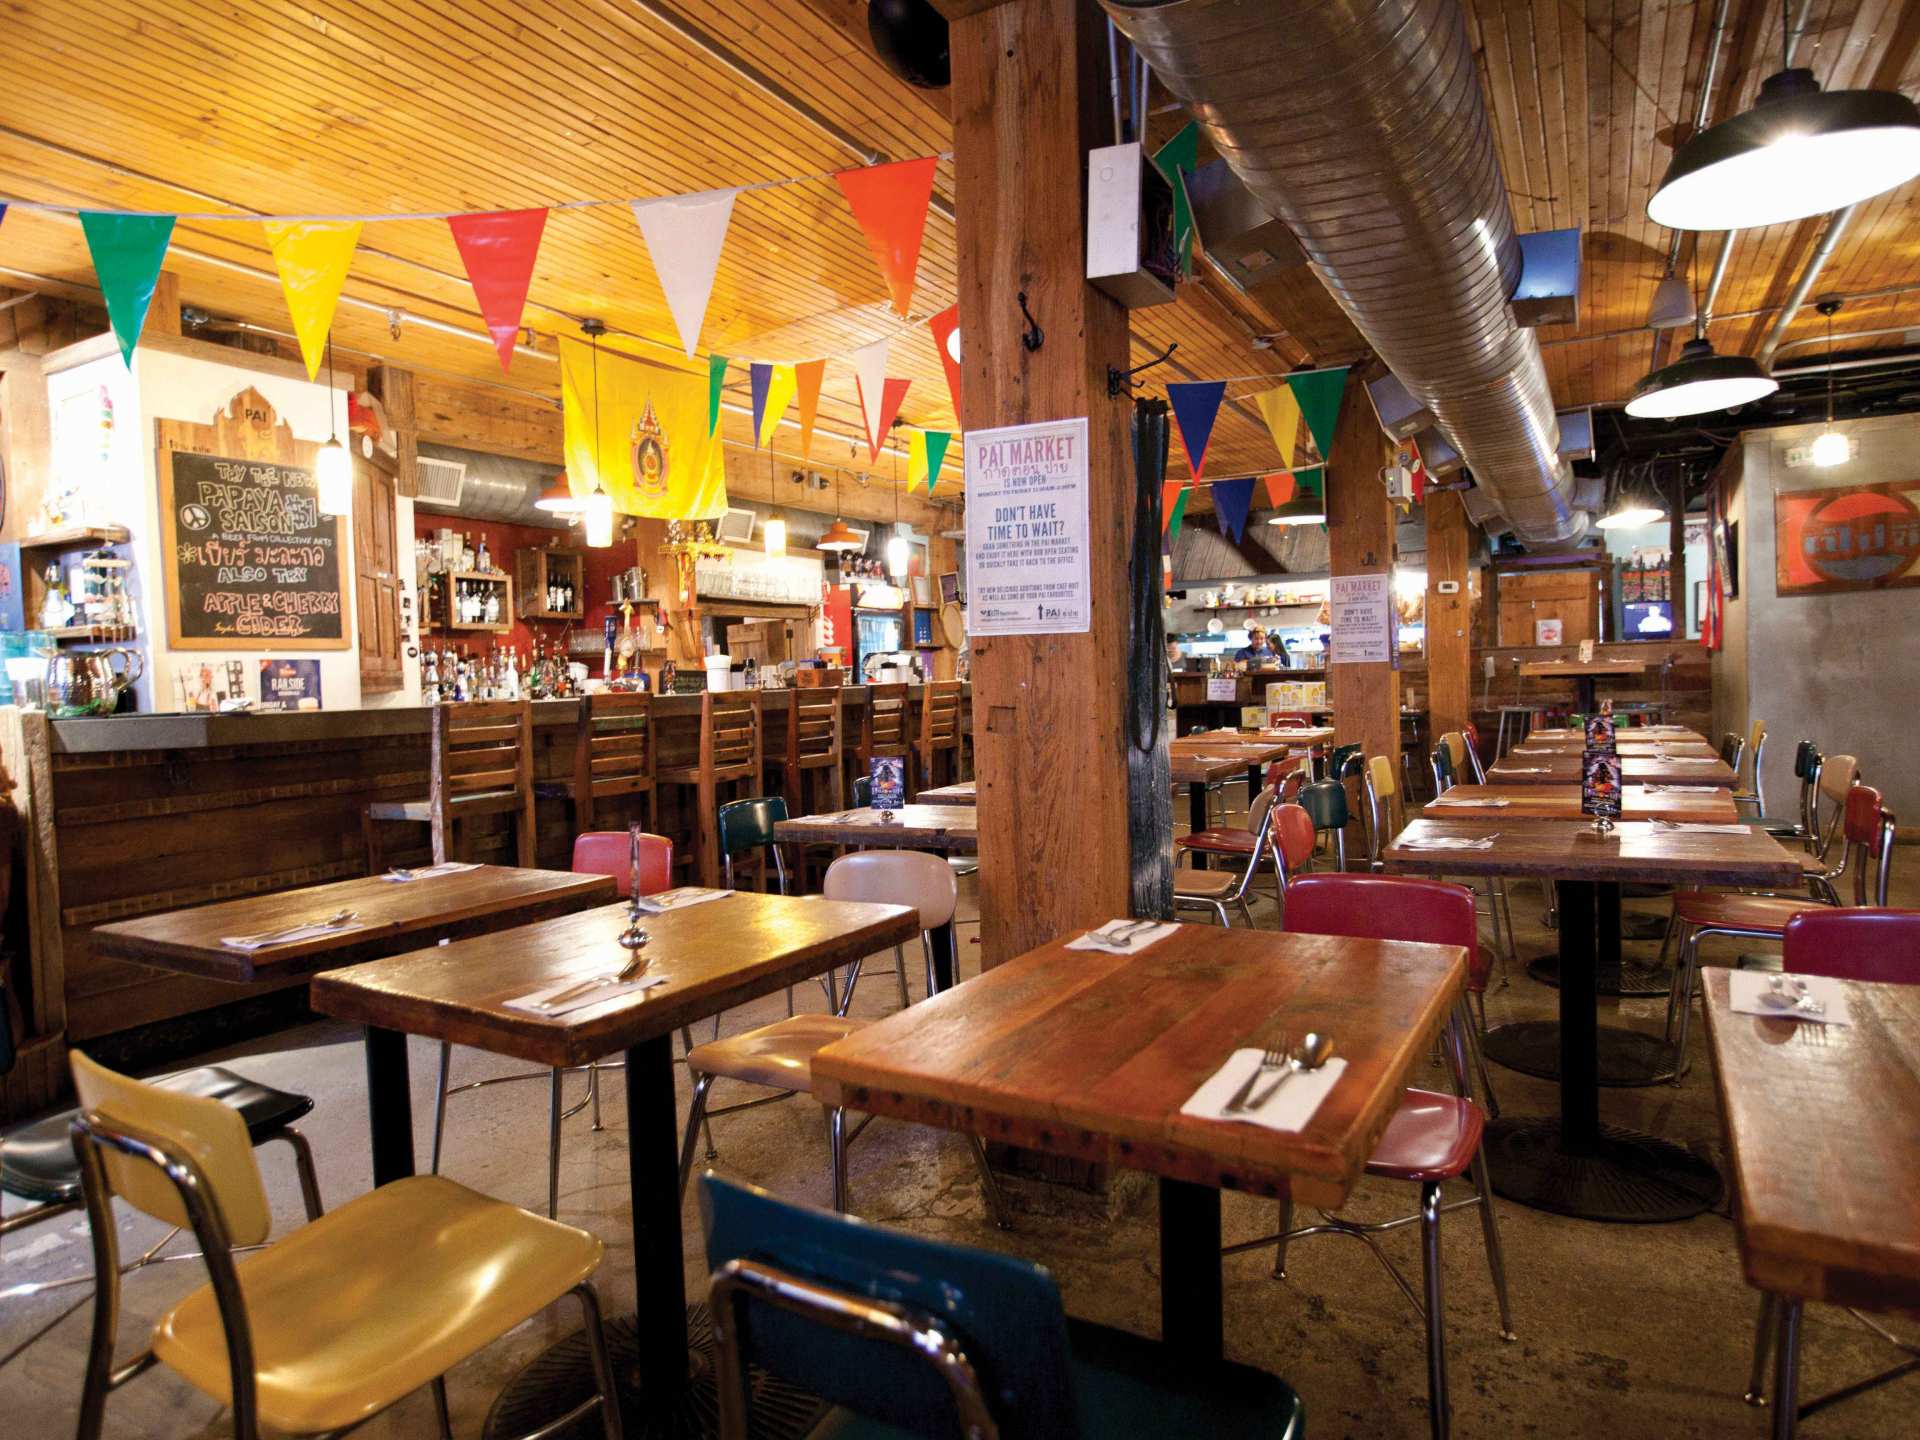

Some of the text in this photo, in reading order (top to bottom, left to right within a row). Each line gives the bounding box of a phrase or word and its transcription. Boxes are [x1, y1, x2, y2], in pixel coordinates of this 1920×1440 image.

[245, 408, 267, 423] PAI
[979, 436, 1074, 470] PAI MARKET
[214, 462, 247, 483] TRY
[250, 467, 280, 488] THE
[1029, 474, 1046, 486] OPEN
[197, 481, 287, 514] PAPAYA
[219, 508, 295, 535] SAISON
[995, 503, 1056, 523] DON'T HAVE
[987, 520, 1065, 541] TIME TO WAIT?
[217, 566, 308, 584] ALSO TRY
[1335, 580, 1381, 593] PAI MARKET
[204, 591, 339, 616] APPLE & CHERRY
[1046, 608, 1061, 617] PAI
[236, 615, 303, 636] CIDER
